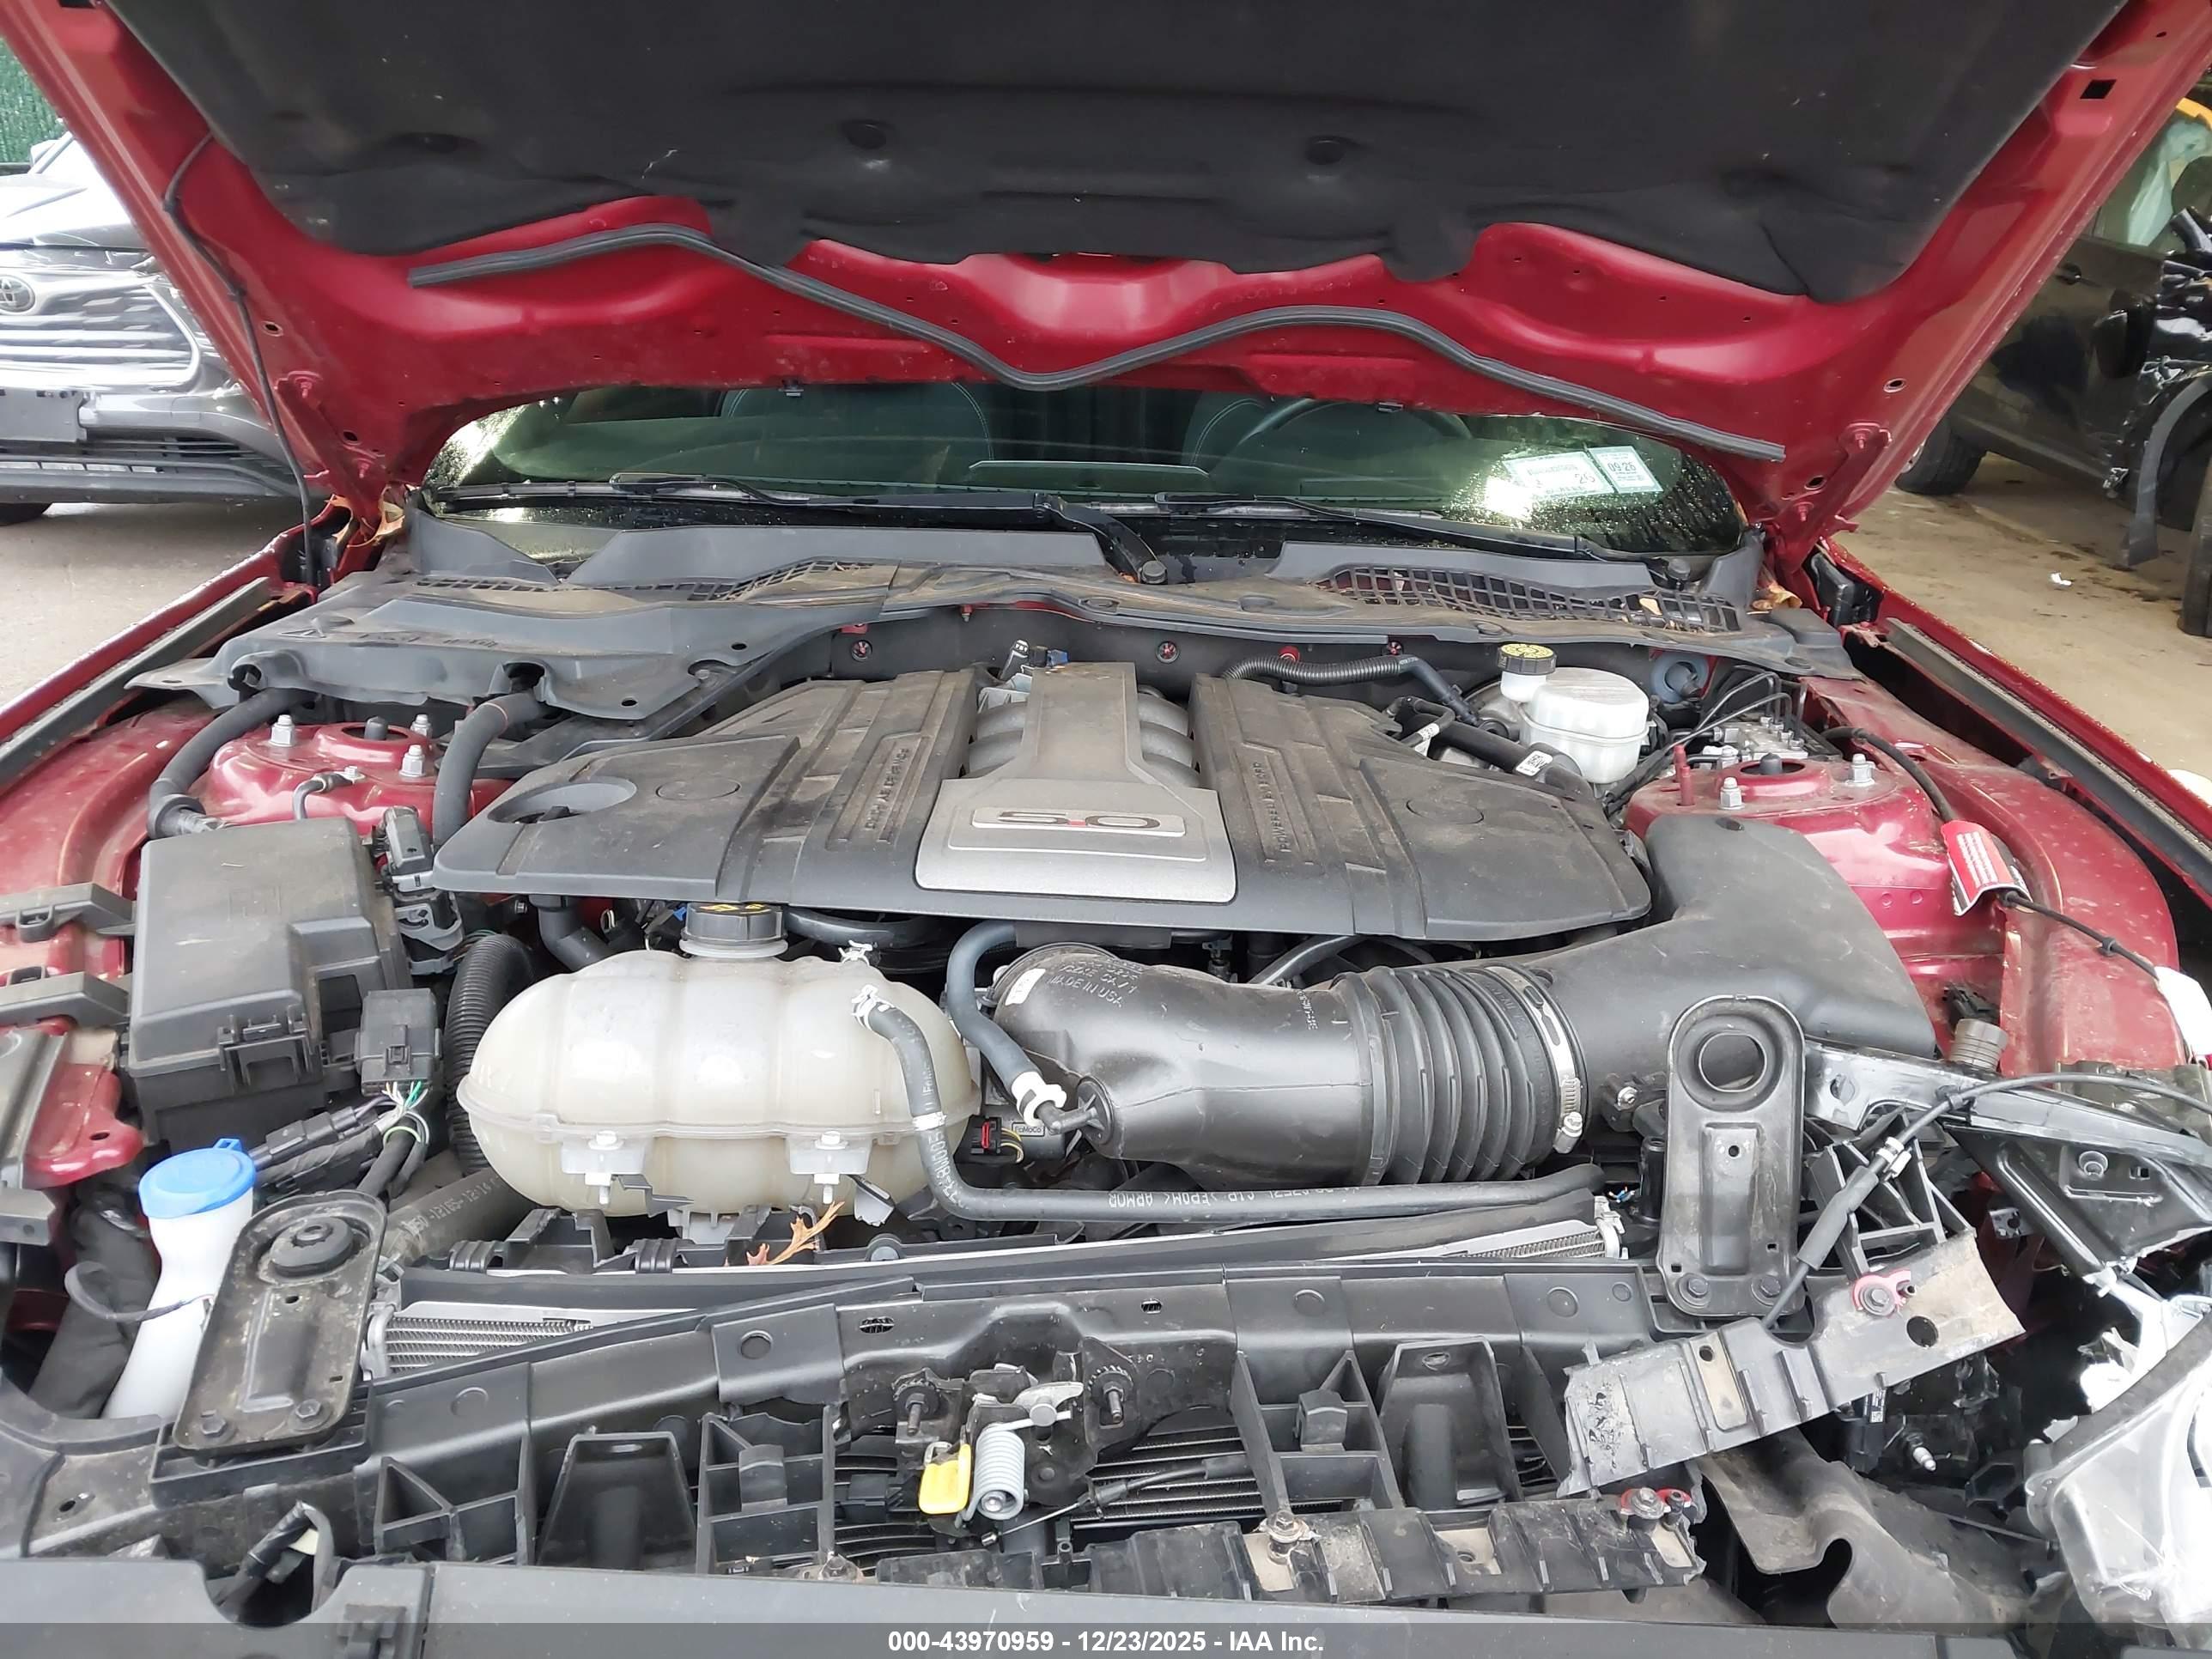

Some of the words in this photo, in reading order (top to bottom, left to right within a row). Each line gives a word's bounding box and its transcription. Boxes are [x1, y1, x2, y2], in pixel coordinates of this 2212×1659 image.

[997, 811, 1161, 830] 5.0
[1047, 975, 1085, 989] MADE
[1083, 981, 1099, 994] IN
[1097, 988, 1126, 1008] USA
[1109, 1192, 1153, 1208] ARMOR
